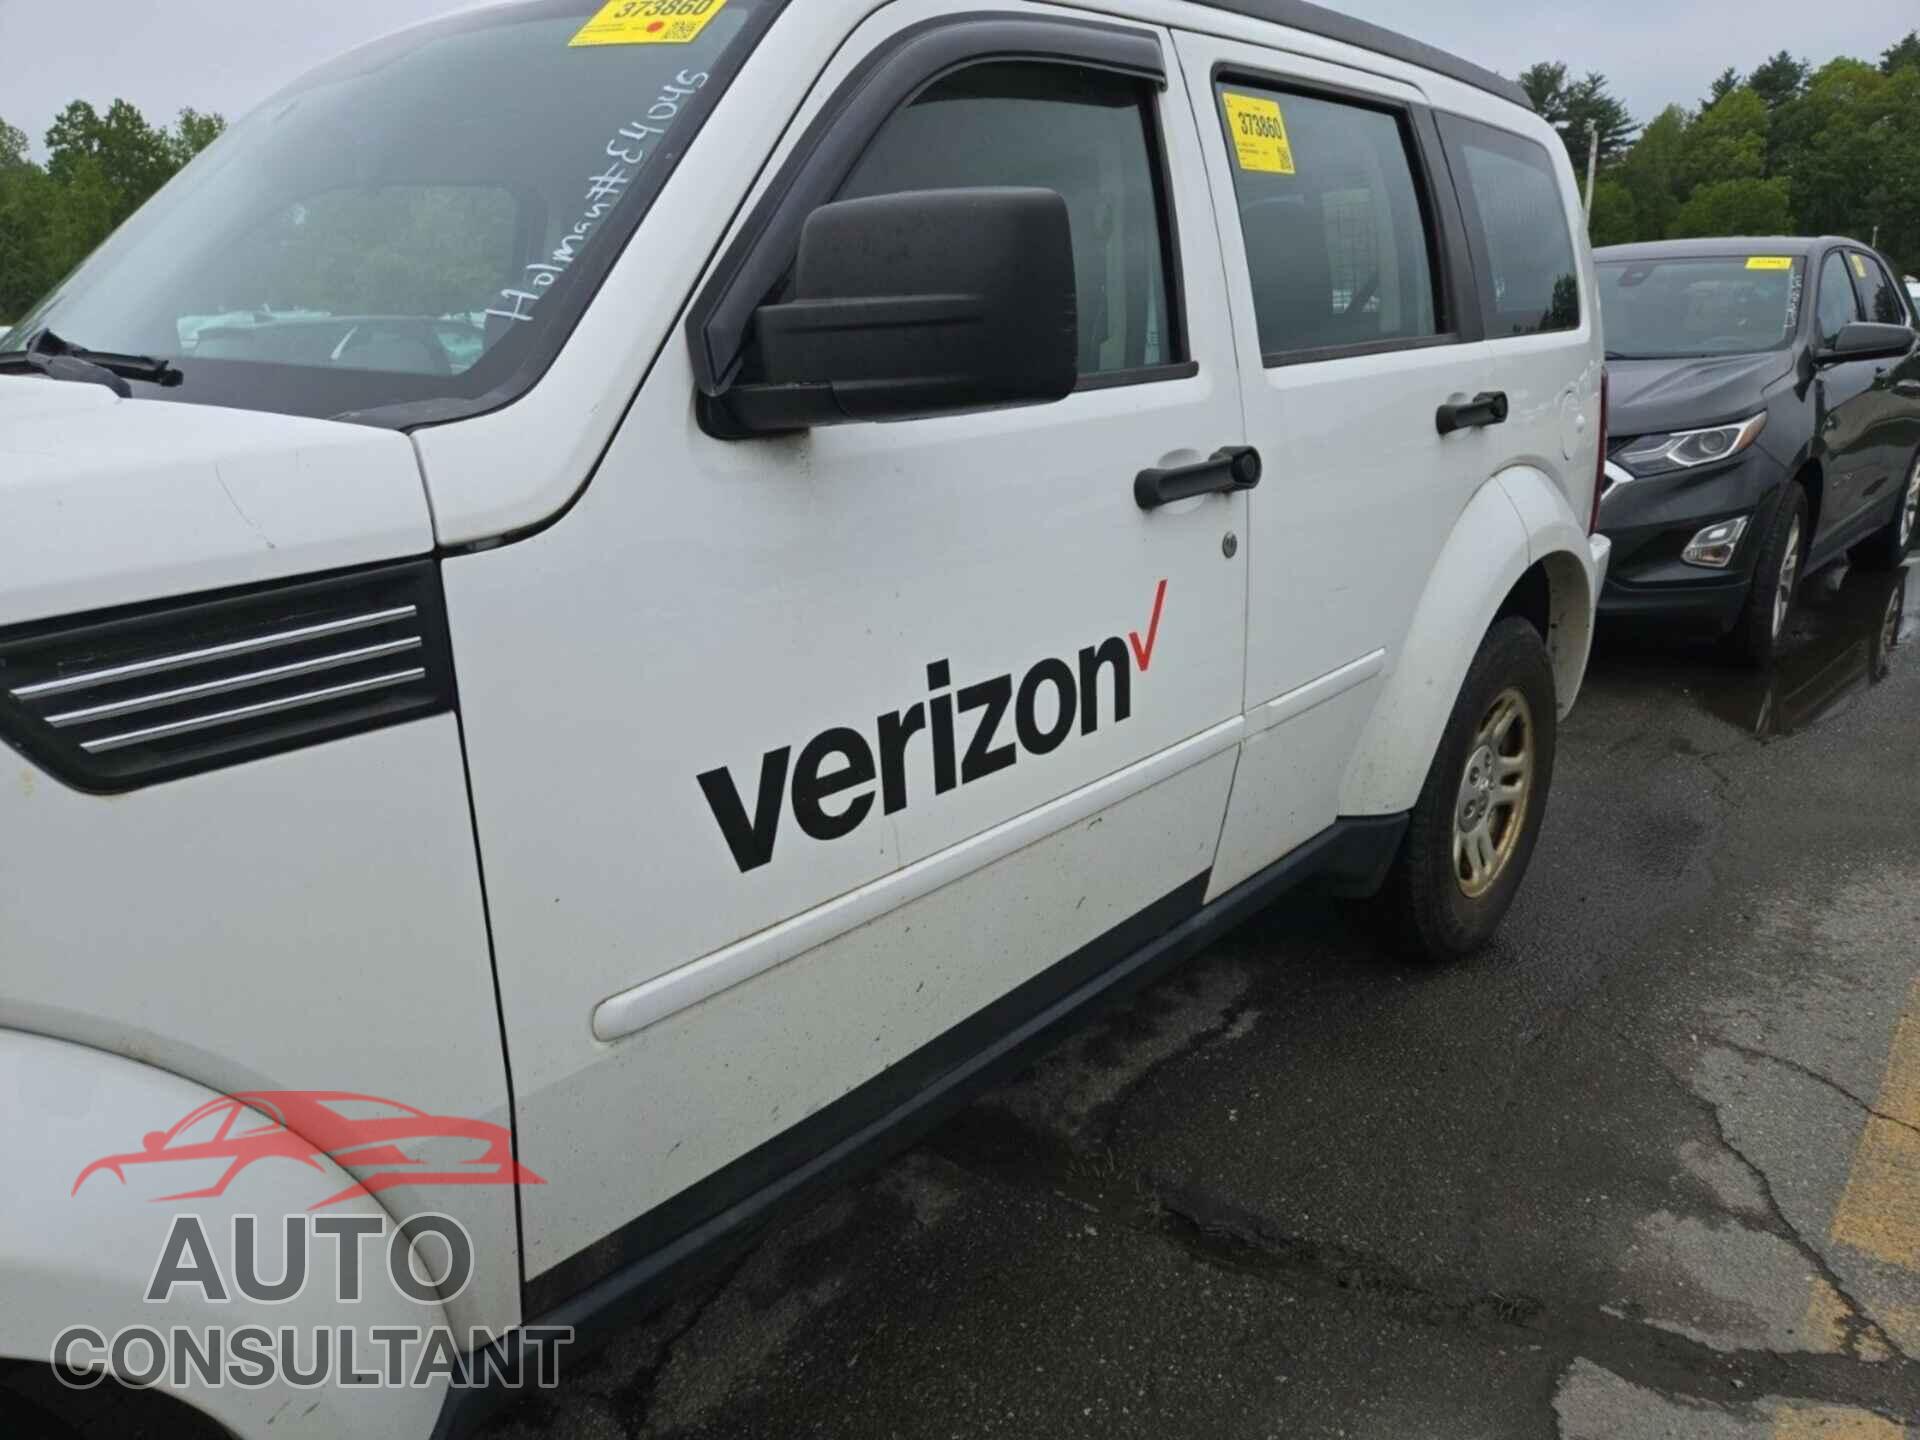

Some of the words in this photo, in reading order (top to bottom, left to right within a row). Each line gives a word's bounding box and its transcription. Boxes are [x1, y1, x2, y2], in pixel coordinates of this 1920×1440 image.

[613, 0, 712, 18] 373860
[1238, 111, 1282, 140] 373860
[696, 636, 1131, 873] verizon
